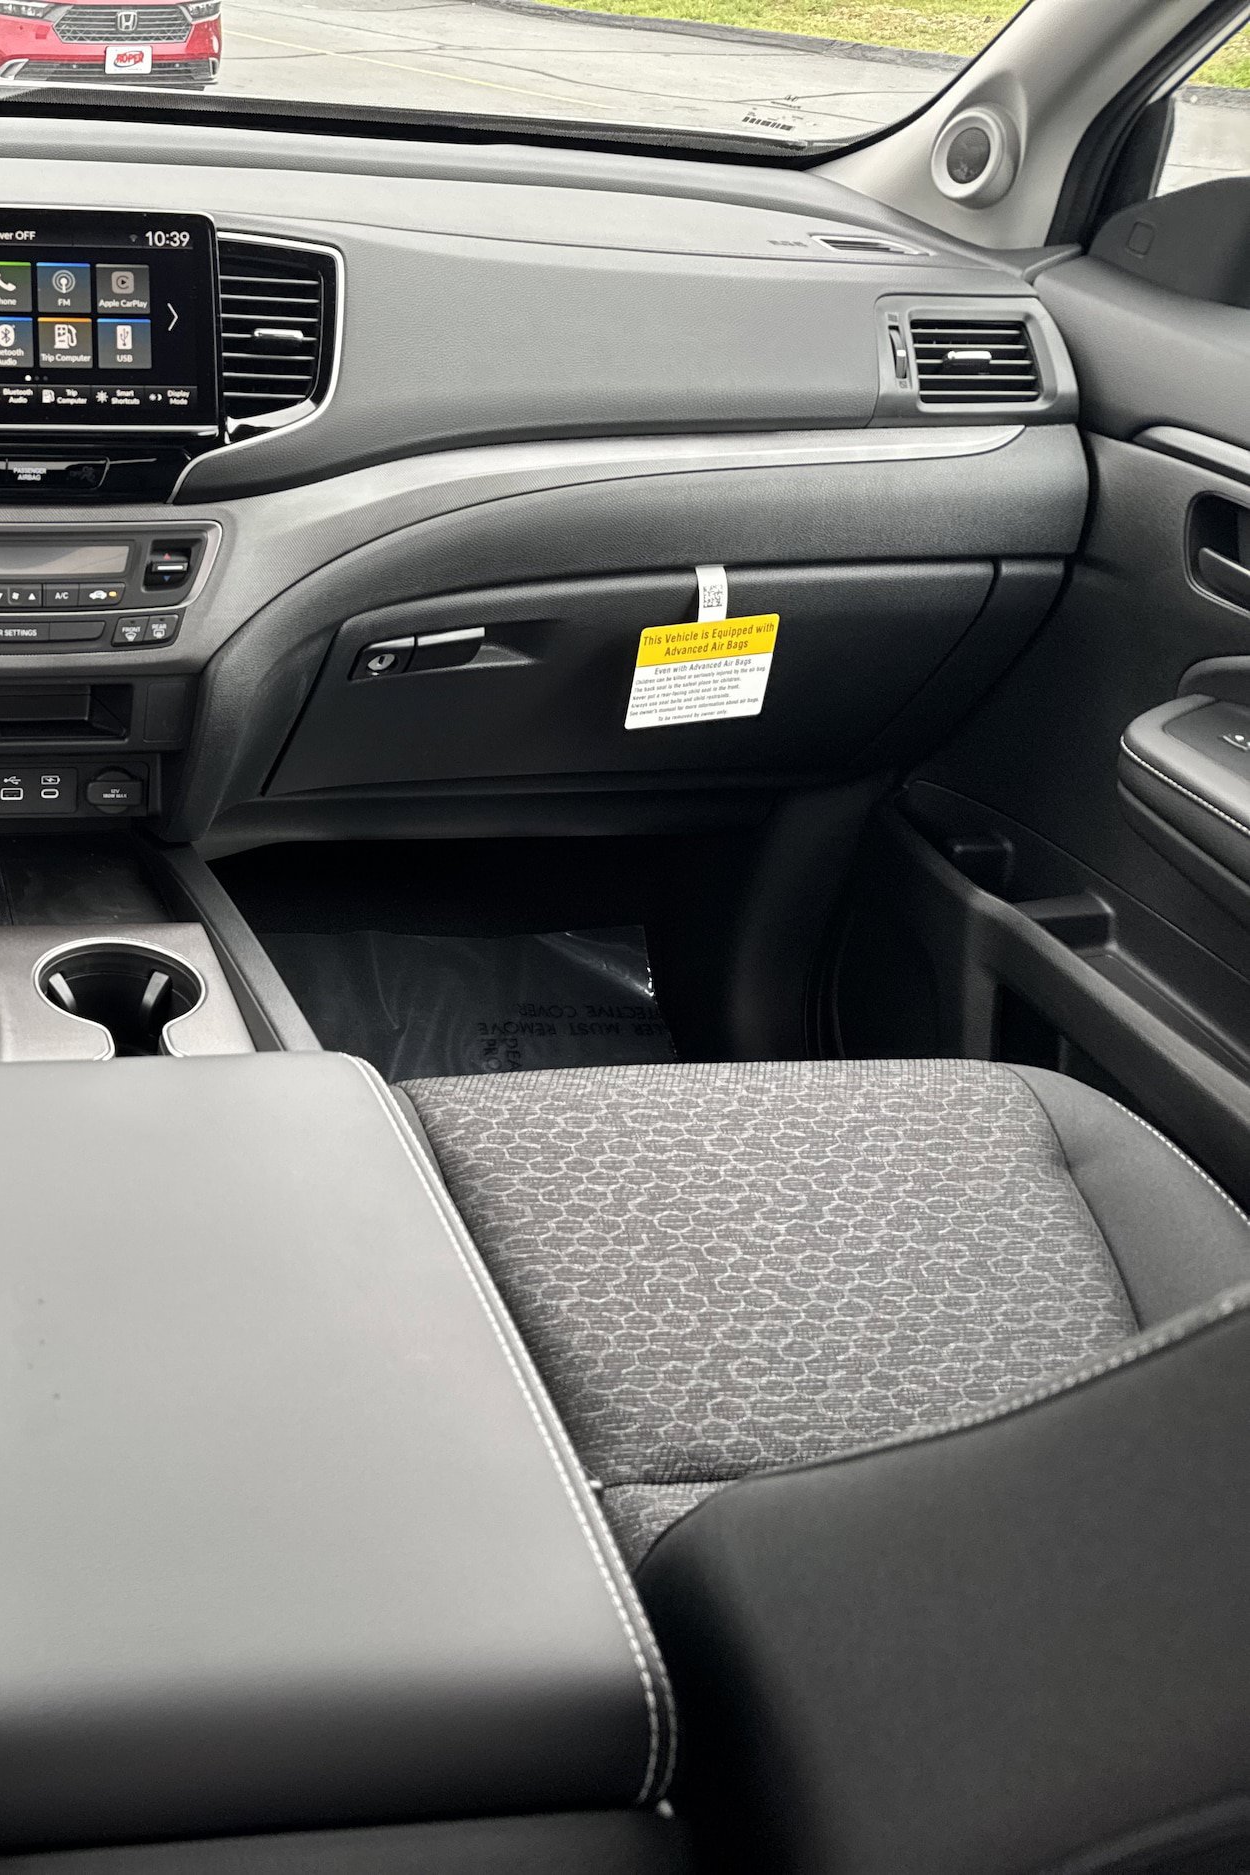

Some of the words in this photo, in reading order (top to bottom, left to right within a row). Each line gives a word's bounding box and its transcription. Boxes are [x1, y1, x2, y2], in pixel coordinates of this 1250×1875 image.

[15, 231, 36, 240] OFF
[145, 231, 190, 247] 10:39
[58, 298, 71, 306] FM
[99, 299, 120, 308] Apple
[121, 299, 148, 309] CarPlay
[41, 354, 54, 363] Trip
[55, 354, 91, 363] Computer
[116, 354, 133, 362] USB
[2, 388, 34, 396] Bluetooth
[66, 389, 78, 397] Trip
[167, 390, 190, 398] Display
[8, 396, 28, 404] Audio
[56, 396, 88, 405] Computer
[55, 592, 69, 600] A/C
[643, 635, 662, 646] This
[665, 630, 698, 643] Vehicle
[701, 630, 709, 640] is
[712, 625, 754, 639] Equipped
[756, 622, 774, 634] with
[664, 642, 708, 656] Advanced
[711, 642, 726, 652] Air
[726, 640, 748, 650] Bags
[689, 661, 722, 670] Advanced
[735, 658, 752, 666] Bags
